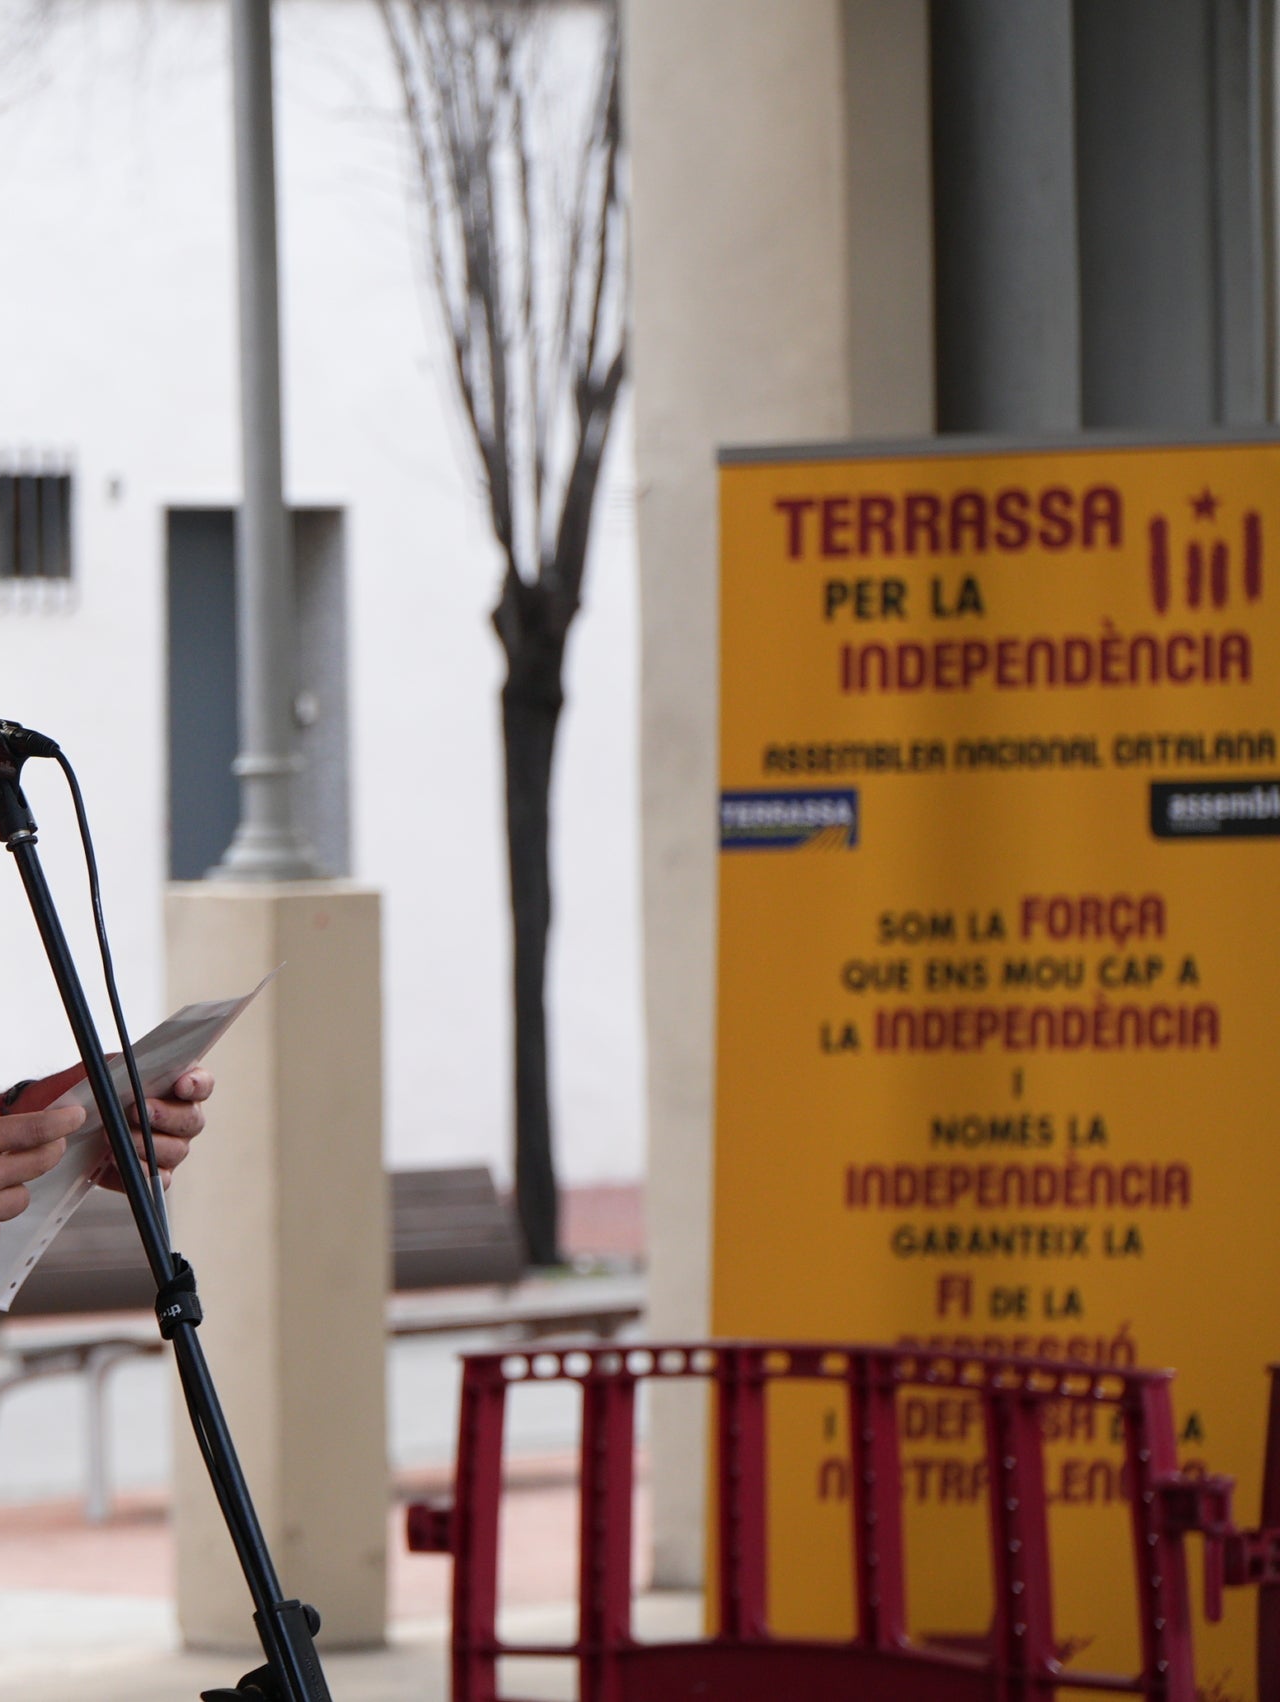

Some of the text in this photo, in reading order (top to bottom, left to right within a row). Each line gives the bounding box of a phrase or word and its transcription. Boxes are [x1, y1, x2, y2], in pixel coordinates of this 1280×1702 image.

[774, 485, 1123, 561] TERRASSA
[823, 574, 985, 621] PER LA
[840, 617, 1252, 694] INDEPENDÈNCIA
[763, 729, 1276, 775] ASSEMBLEA NACIONAL CATALANA
[878, 893, 1166, 951] SOM LA FORÇA
[841, 955, 1199, 994] QUE ENS MOU CAP A
[821, 993, 1220, 1055] LA INDEPENDÈNCIA
[1011, 1068, 1024, 1100] I
[930, 1112, 1108, 1149] NOMÉS LA
[844, 1151, 1192, 1211] INDEPENDÈNCIA
[891, 1225, 1144, 1258] GARANTEIX LA
[936, 1274, 1082, 1320] FI DE LA
